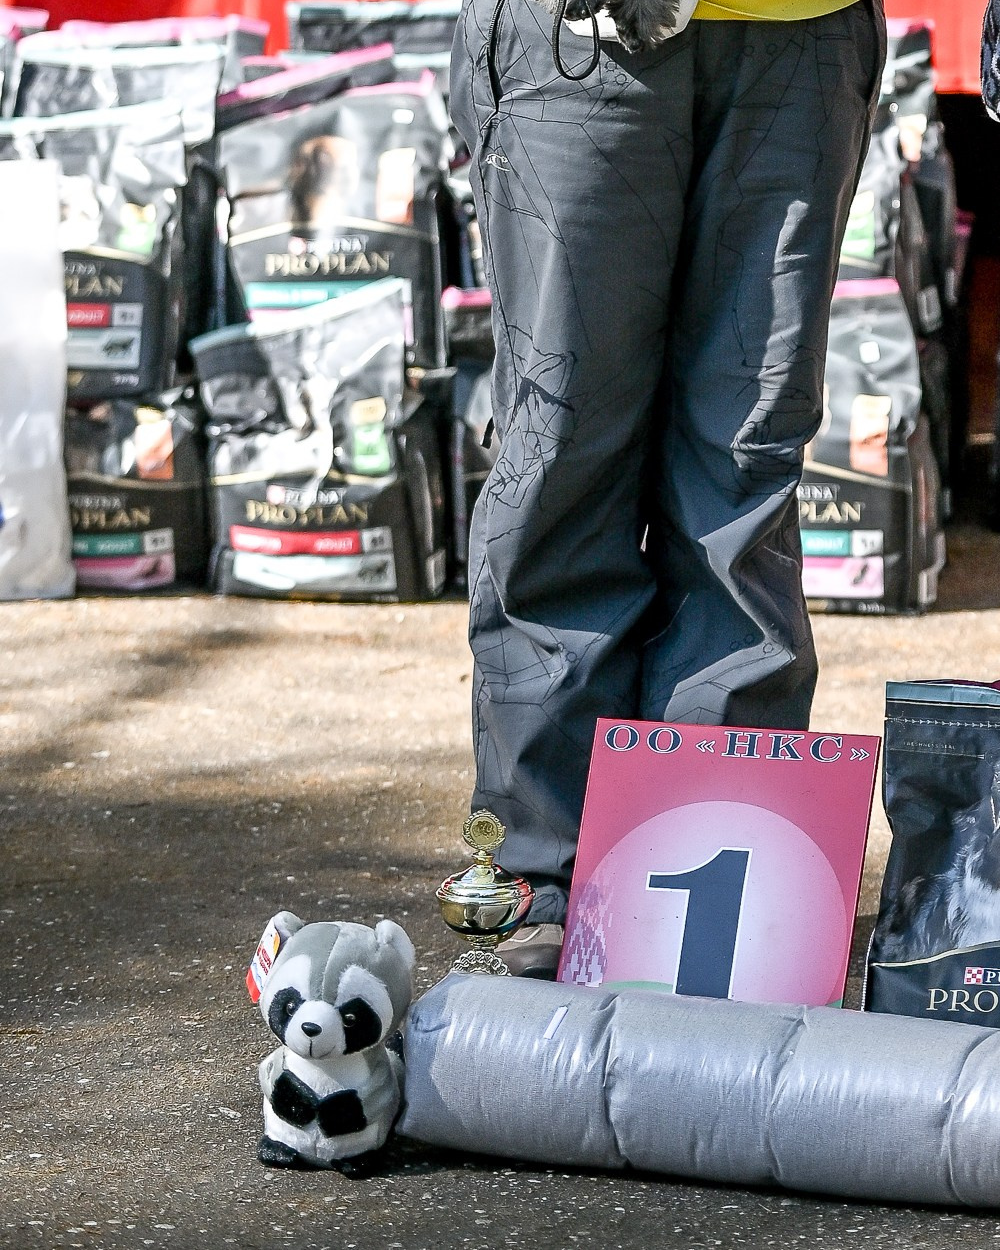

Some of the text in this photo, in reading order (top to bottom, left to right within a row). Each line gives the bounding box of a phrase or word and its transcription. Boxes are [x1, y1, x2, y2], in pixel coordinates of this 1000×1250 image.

[320, 252, 390, 276] PLAN
[246, 500, 297, 526] PRO
[799, 501, 861, 524] PLAN
[604, 724, 871, 763] ОО «НКС»
[903, 741, 939, 749] FRESHNESS
[645, 846, 753, 1000] 1
[925, 988, 999, 1014] PRO
